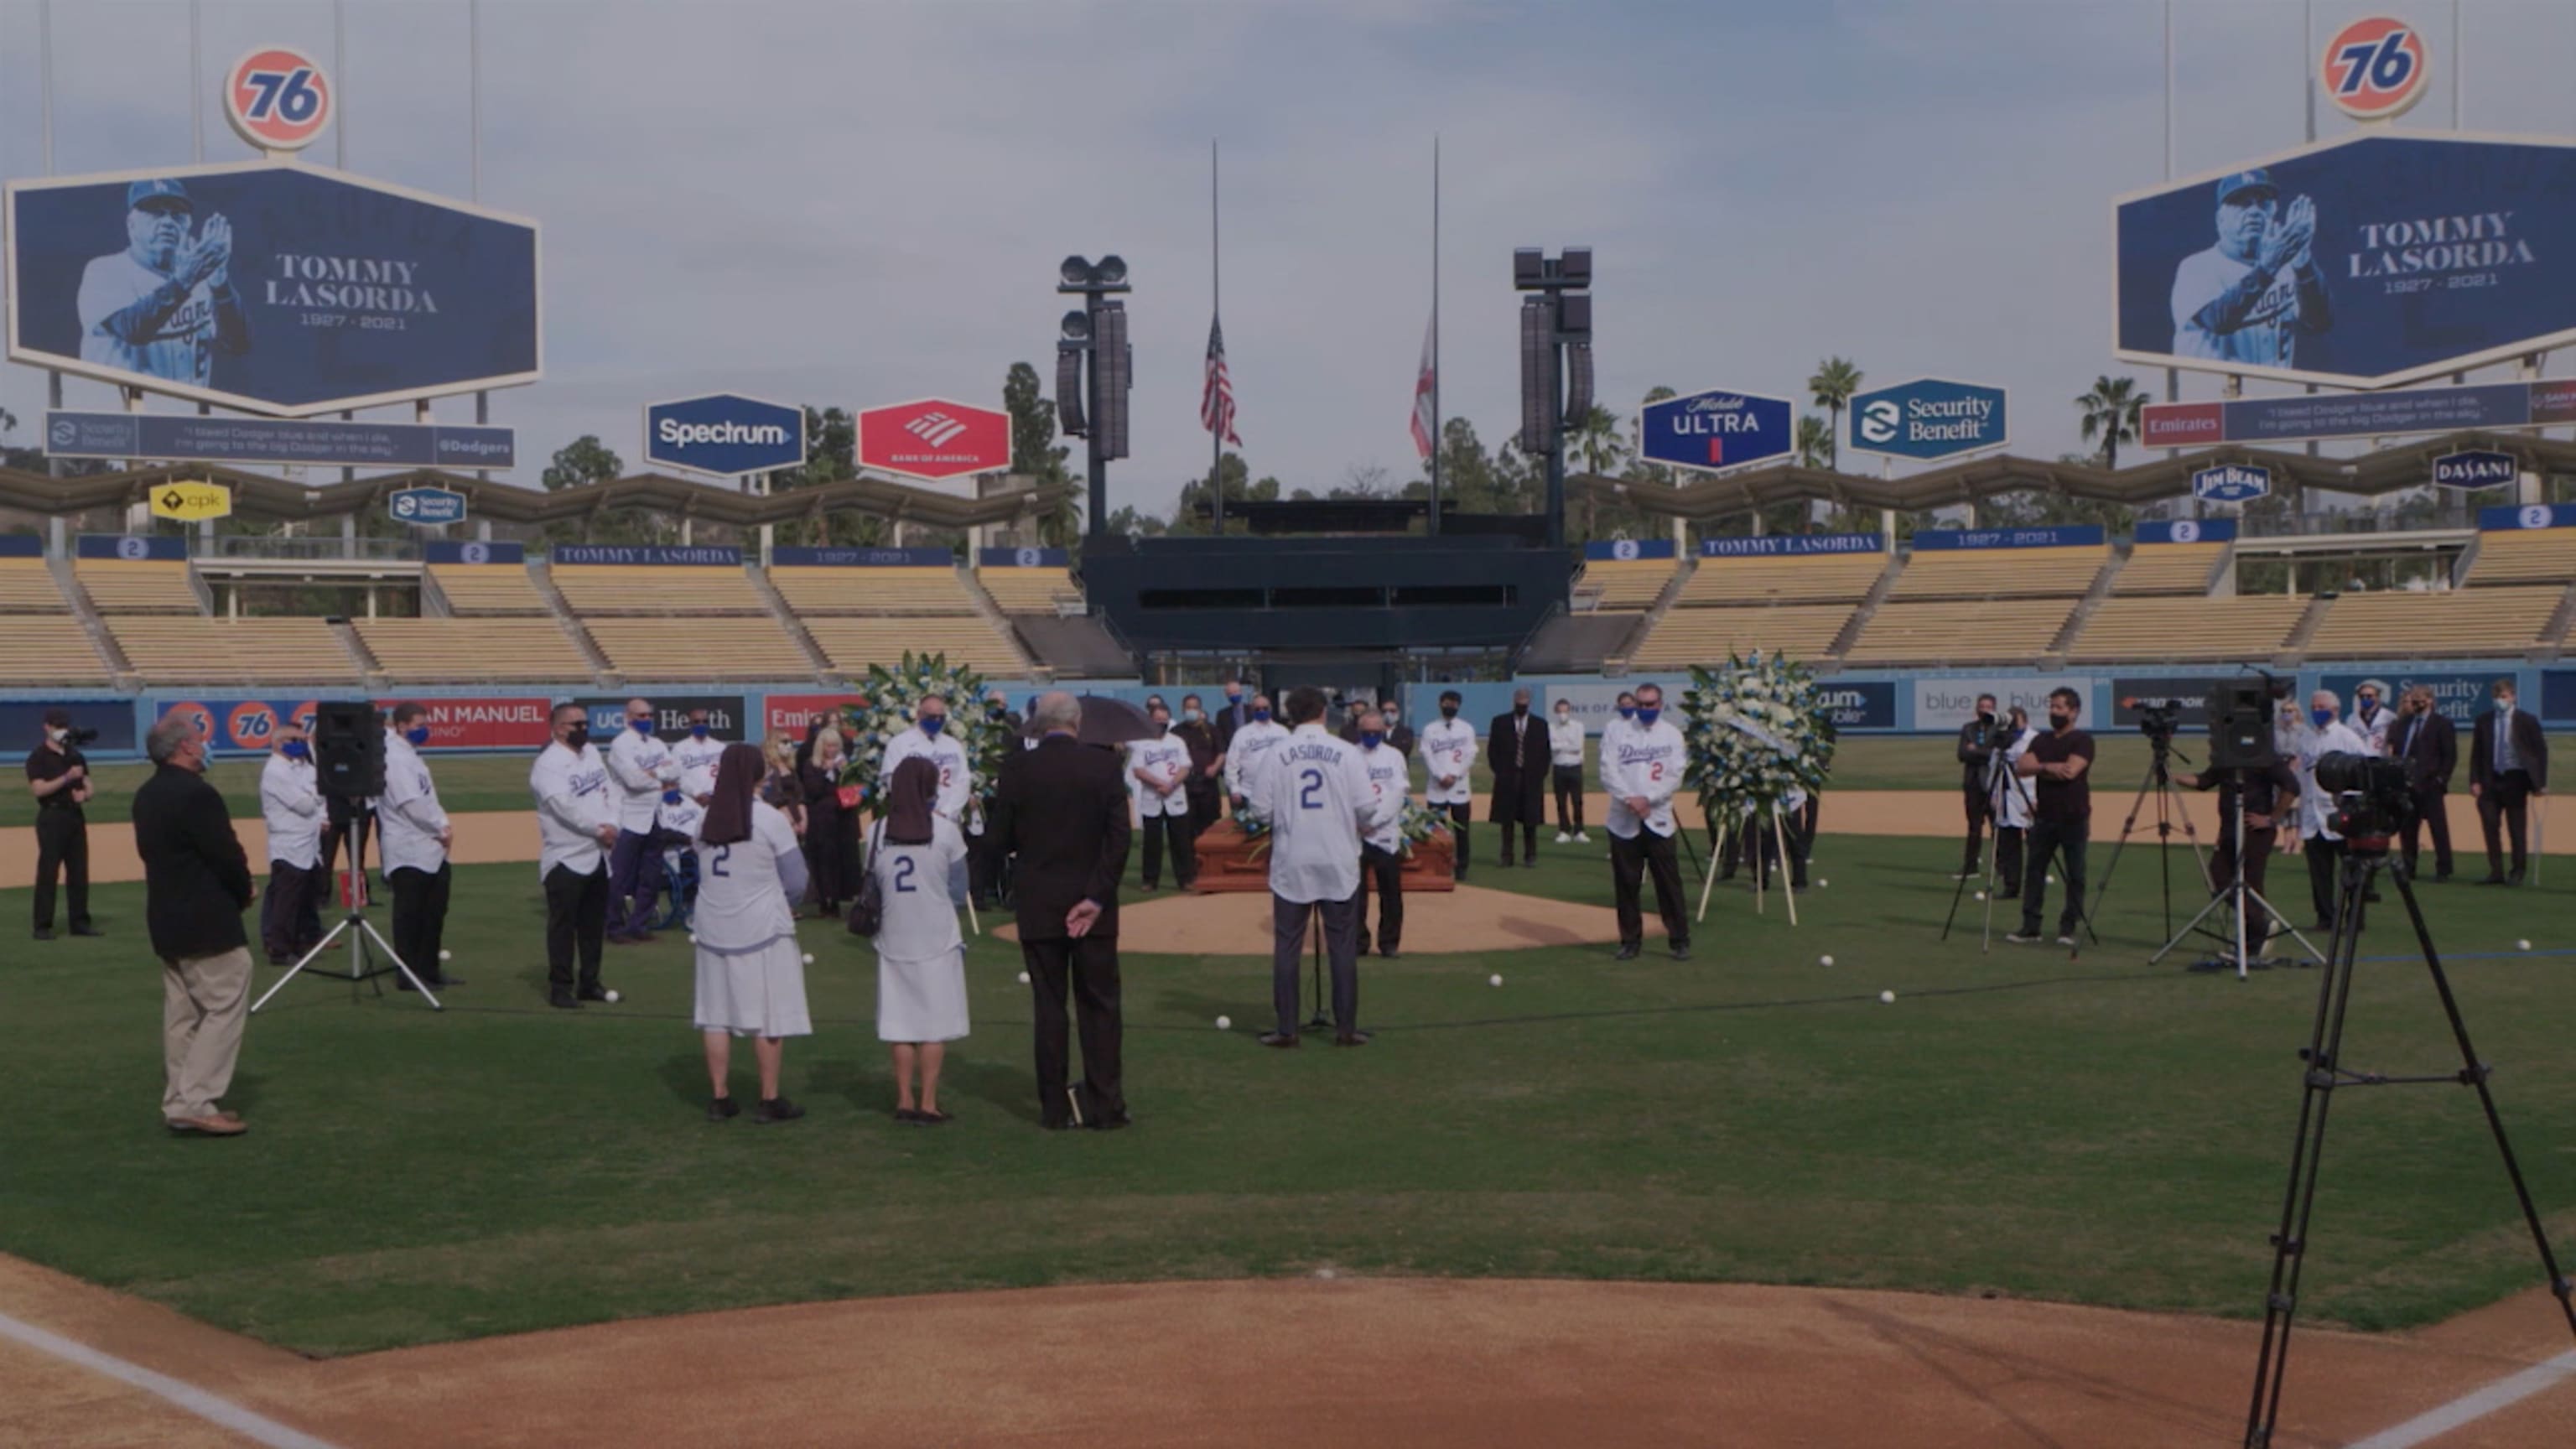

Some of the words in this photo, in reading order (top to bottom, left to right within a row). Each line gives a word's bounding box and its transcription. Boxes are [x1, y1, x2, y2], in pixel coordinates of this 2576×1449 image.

[2334, 29, 2415, 96] 76
[244, 67, 321, 125] 76
[2360, 210, 2516, 250] TOMMY
[2349, 239, 2536, 278] LASORDA
[275, 253, 418, 286] TOMMY
[2384, 278, 2433, 294] 1927
[2448, 273, 2498, 289] 2021
[264, 280, 439, 314] LASORDA
[299, 313, 346, 327] 1927
[360, 315, 406, 330] 2021
[1908, 396, 1993, 420] Security
[2313, 405, 2355, 416] Dodger
[2359, 402, 2386, 413] blue
[2388, 400, 2412, 409] and
[2415, 398, 2448, 409] when
[80, 422, 132, 437] Security
[1673, 413, 1760, 435] ULTRA
[1909, 418, 1982, 441] Benefit
[2150, 418, 2218, 434] Emirates
[2278, 419, 2312, 432] going
[2313, 418, 2326, 428] to
[2328, 417, 2348, 426] the
[2350, 415, 2371, 427] big
[2372, 413, 2416, 424] Dodger
[2433, 410, 2453, 419] the
[231, 428, 275, 440] Dodger
[278, 429, 303, 439] blue
[307, 431, 328, 440] and
[331, 433, 362, 442] when
[659, 418, 786, 448] Spectrum
[195, 439, 230, 451] going
[231, 441, 244, 449] to
[247, 441, 267, 450] the
[269, 442, 289, 453] big
[289, 443, 333, 454] Dodger
[348, 444, 369, 454] the
[439, 439, 510, 455] @Dodgers
[891, 454, 919, 463] BANK
[921, 454, 933, 463] OF
[935, 454, 979, 463] AMERICA
[2438, 460, 2511, 480] DASANI
[2197, 471, 2225, 497] JIM
[2226, 467, 2265, 493] BEAM
[187, 492, 221, 510] cpk
[419, 496, 459, 512] Security
[2530, 509, 2541, 524] 2
[1957, 532, 2001, 547] 1927
[2013, 530, 2060, 545] 2021
[2180, 524, 2189, 539] 2
[127, 540, 139, 556] 2
[470, 546, 480, 561] 2
[1622, 543, 1631, 558] 2
[1705, 538, 1780, 554] TOMMY
[1785, 536, 1878, 553] LASORDA
[562, 548, 638, 564] TOMMY
[643, 548, 736, 564] LASORDA
[816, 551, 857, 564] 1927
[870, 551, 911, 564] 2021
[1023, 550, 1034, 564] 2
[1925, 693, 1971, 710] blue
[454, 706, 545, 724] MANUEL
[661, 709, 731, 730] Heth
[236, 712, 273, 737] 76
[1279, 744, 1343, 766] LASORDA
[1453, 749, 1462, 764] 2
[942, 767, 952, 787] 2
[1166, 761, 1177, 776] 2
[1650, 761, 1664, 781] 2
[1301, 768, 1323, 809] 2
[712, 843, 730, 877] 2
[894, 854, 917, 893] 2
